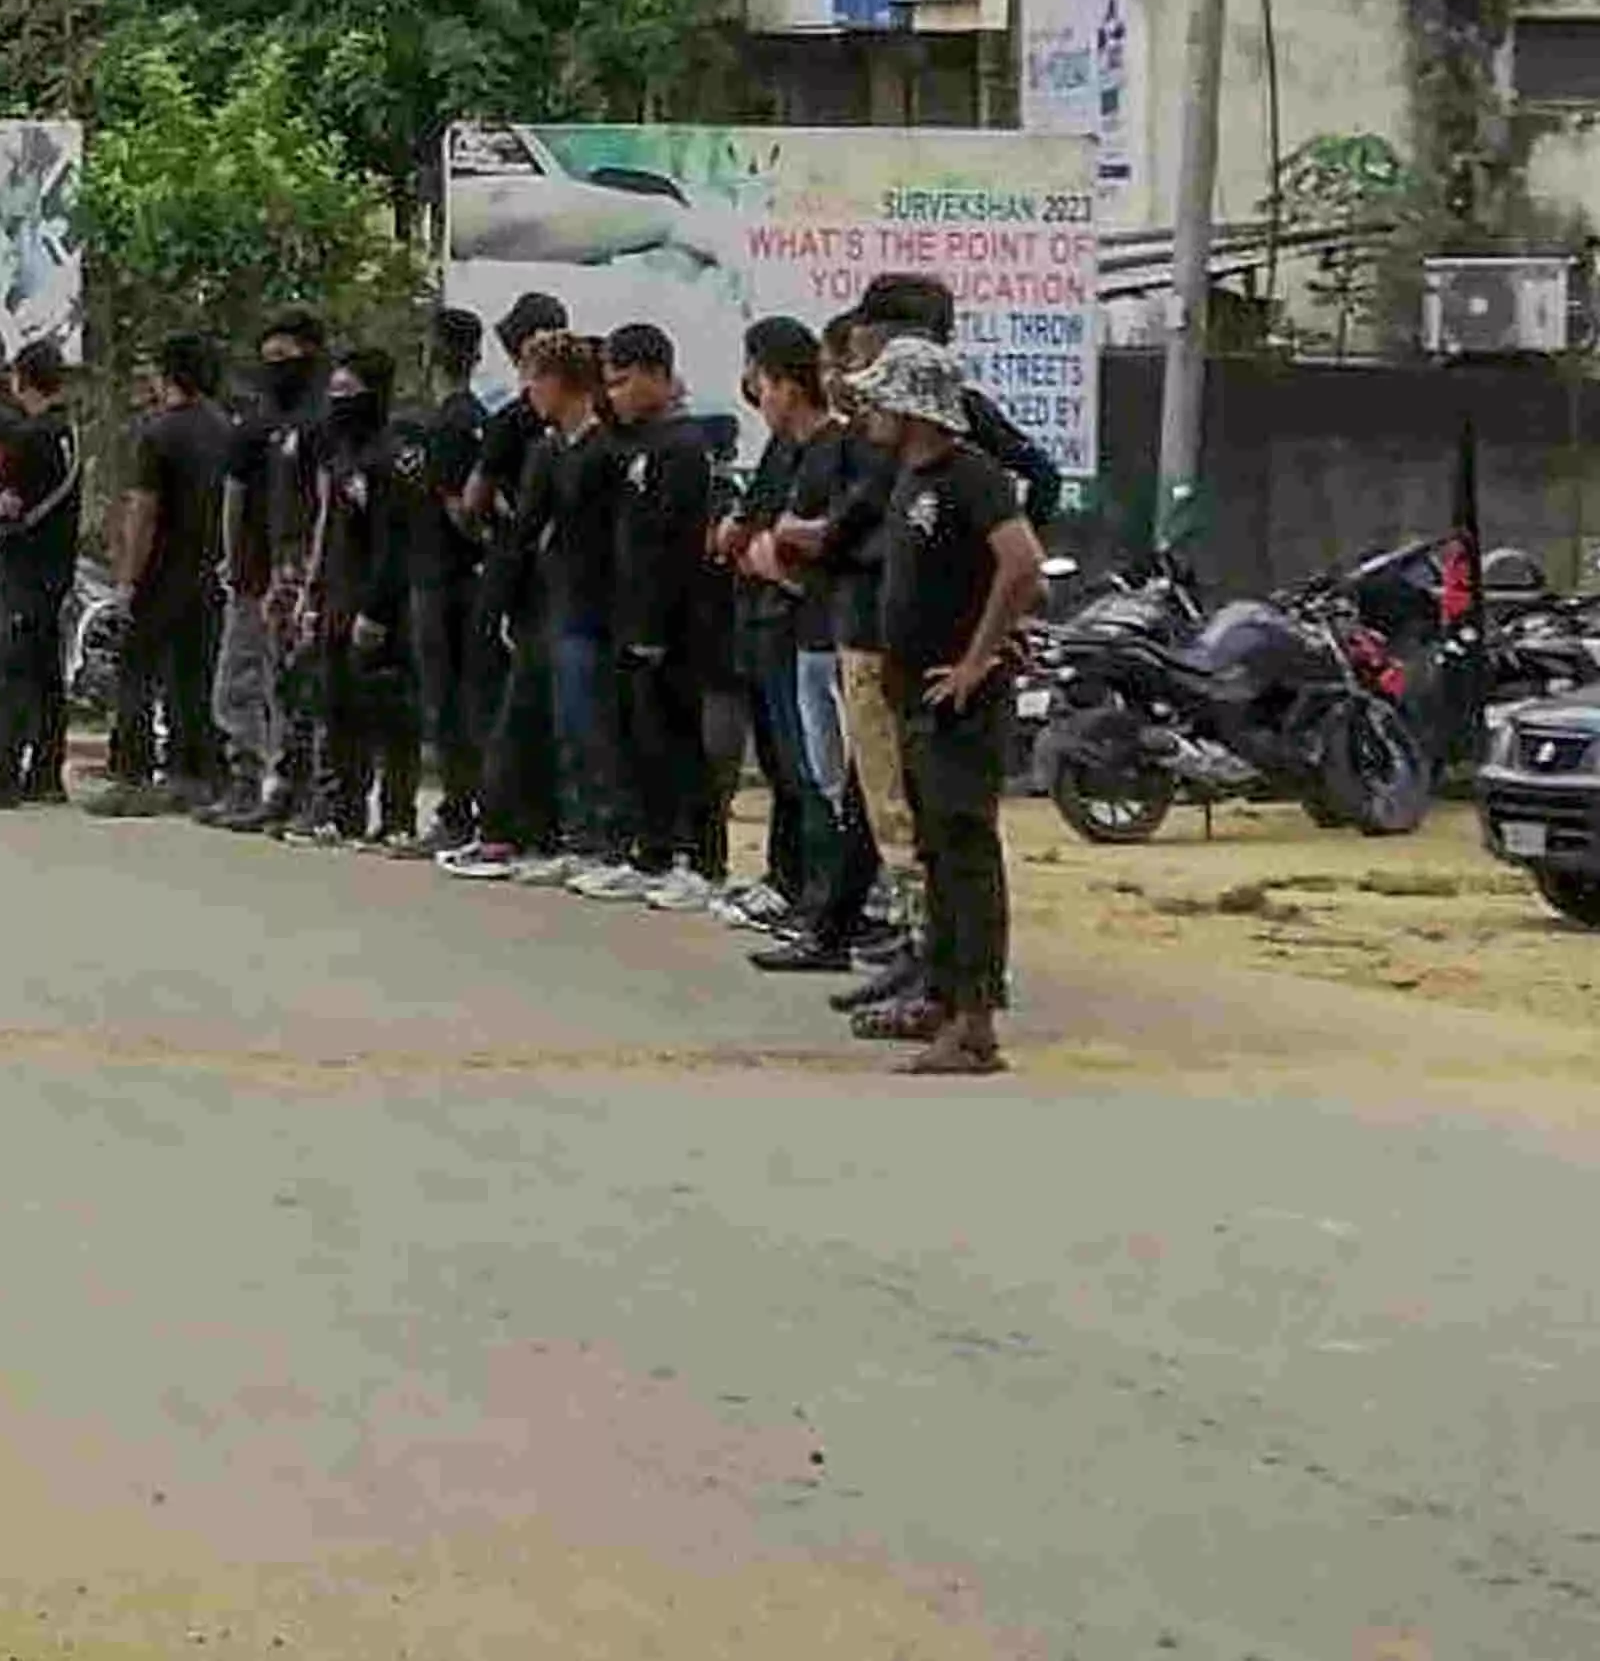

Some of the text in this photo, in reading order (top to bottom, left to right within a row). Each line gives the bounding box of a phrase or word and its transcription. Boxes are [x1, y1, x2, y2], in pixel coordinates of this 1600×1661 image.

[1042, 195, 1092, 223] 2023
[749, 226, 1096, 264] WHAT'S THE POINT OF
[951, 269, 1088, 303] UCATION
[991, 352, 1084, 386] STREETS
